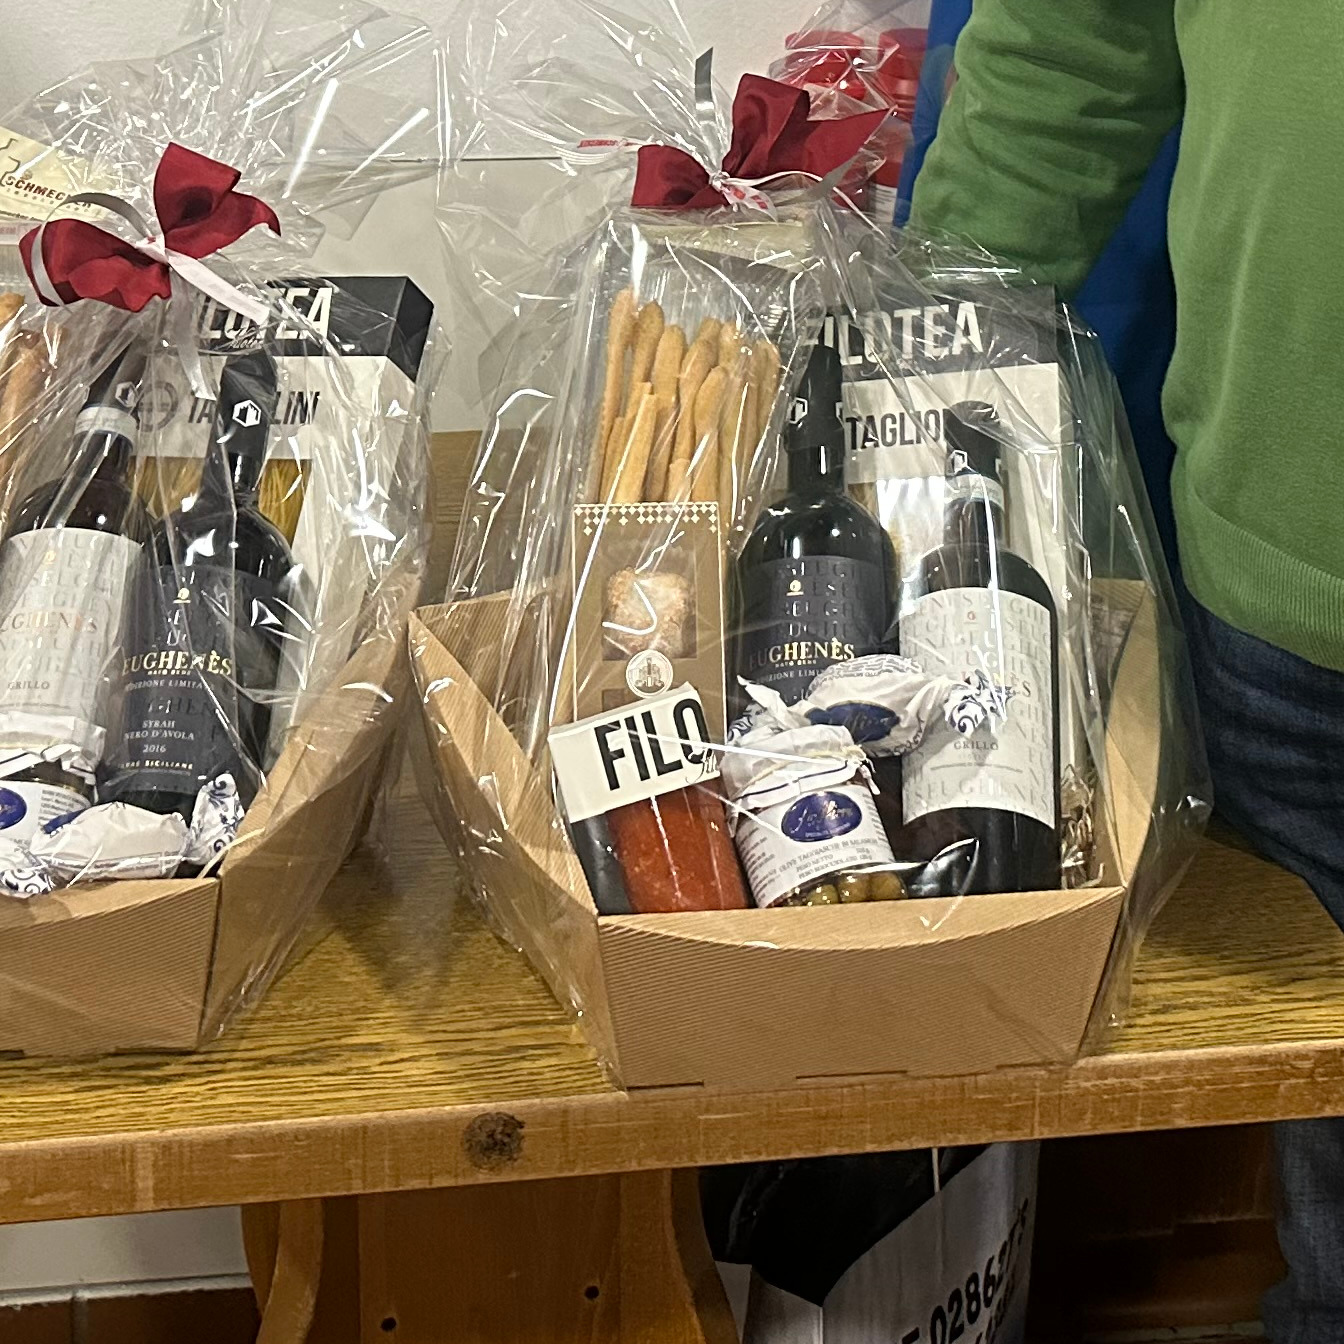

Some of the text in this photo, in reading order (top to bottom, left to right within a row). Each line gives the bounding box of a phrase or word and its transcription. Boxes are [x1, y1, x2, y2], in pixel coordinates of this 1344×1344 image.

[122, 650, 233, 676] EUGHENÈS
[8, 680, 50, 691] GRILLO
[142, 719, 175, 728] SYRAH
[151, 729, 194, 740] D'AVOLA
[142, 744, 167, 753] 2016
[594, 698, 713, 791] FILO
[953, 740, 999, 751] GRILLO
